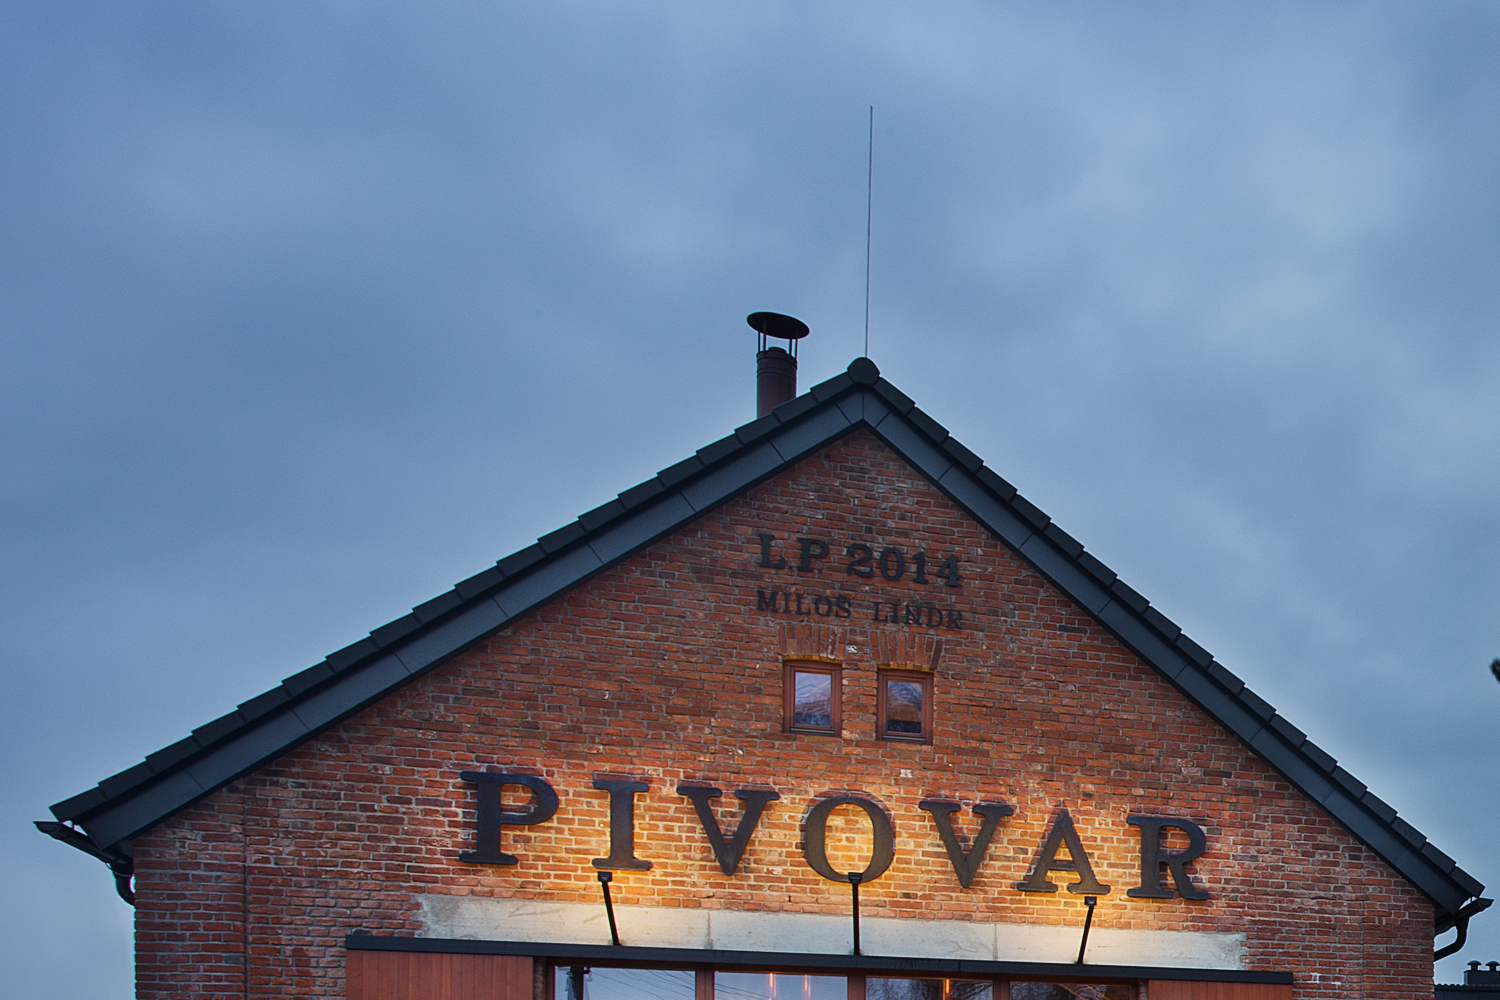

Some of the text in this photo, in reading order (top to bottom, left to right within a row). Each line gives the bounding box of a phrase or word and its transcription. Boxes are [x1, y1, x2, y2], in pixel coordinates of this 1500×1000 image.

[847, 543, 963, 587] 2014
[872, 602, 963, 629] LINDR
[459, 770, 1209, 900] PIVOVAR
